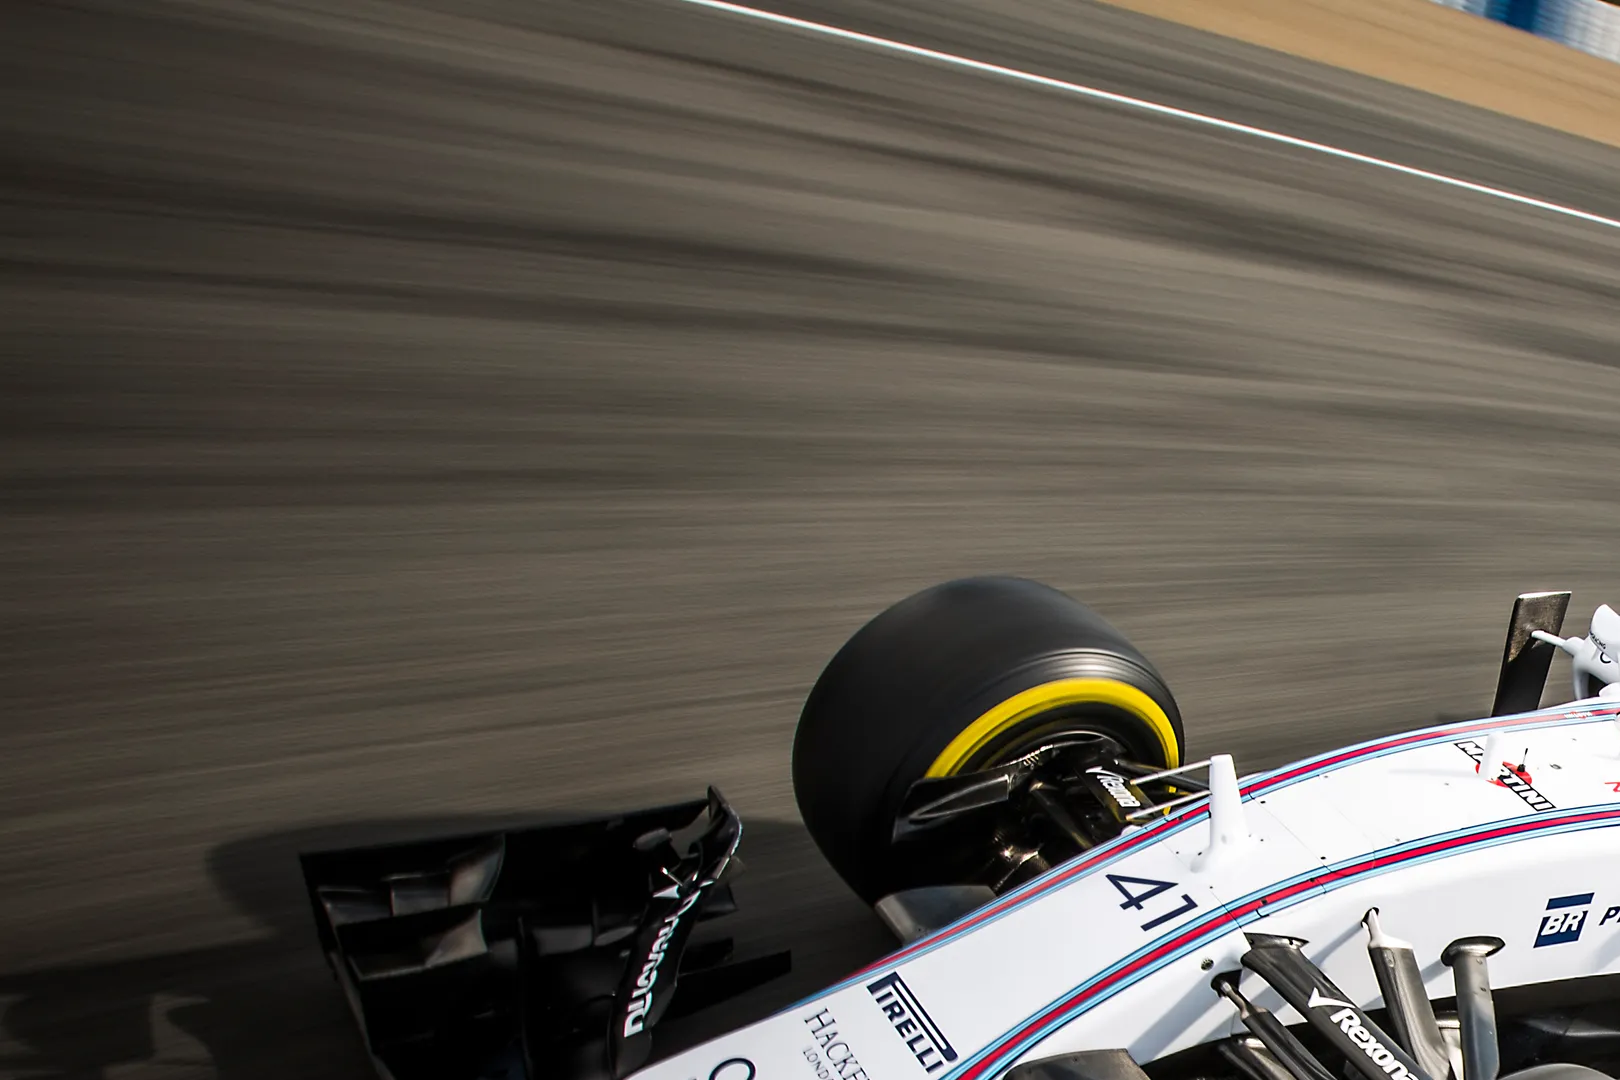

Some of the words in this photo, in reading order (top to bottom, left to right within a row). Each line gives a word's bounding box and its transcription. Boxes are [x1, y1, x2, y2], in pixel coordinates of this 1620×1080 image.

[1455, 741, 1556, 811] MTINI
[1105, 873, 1199, 932] 41
[865, 970, 960, 1075] PIRELLI
